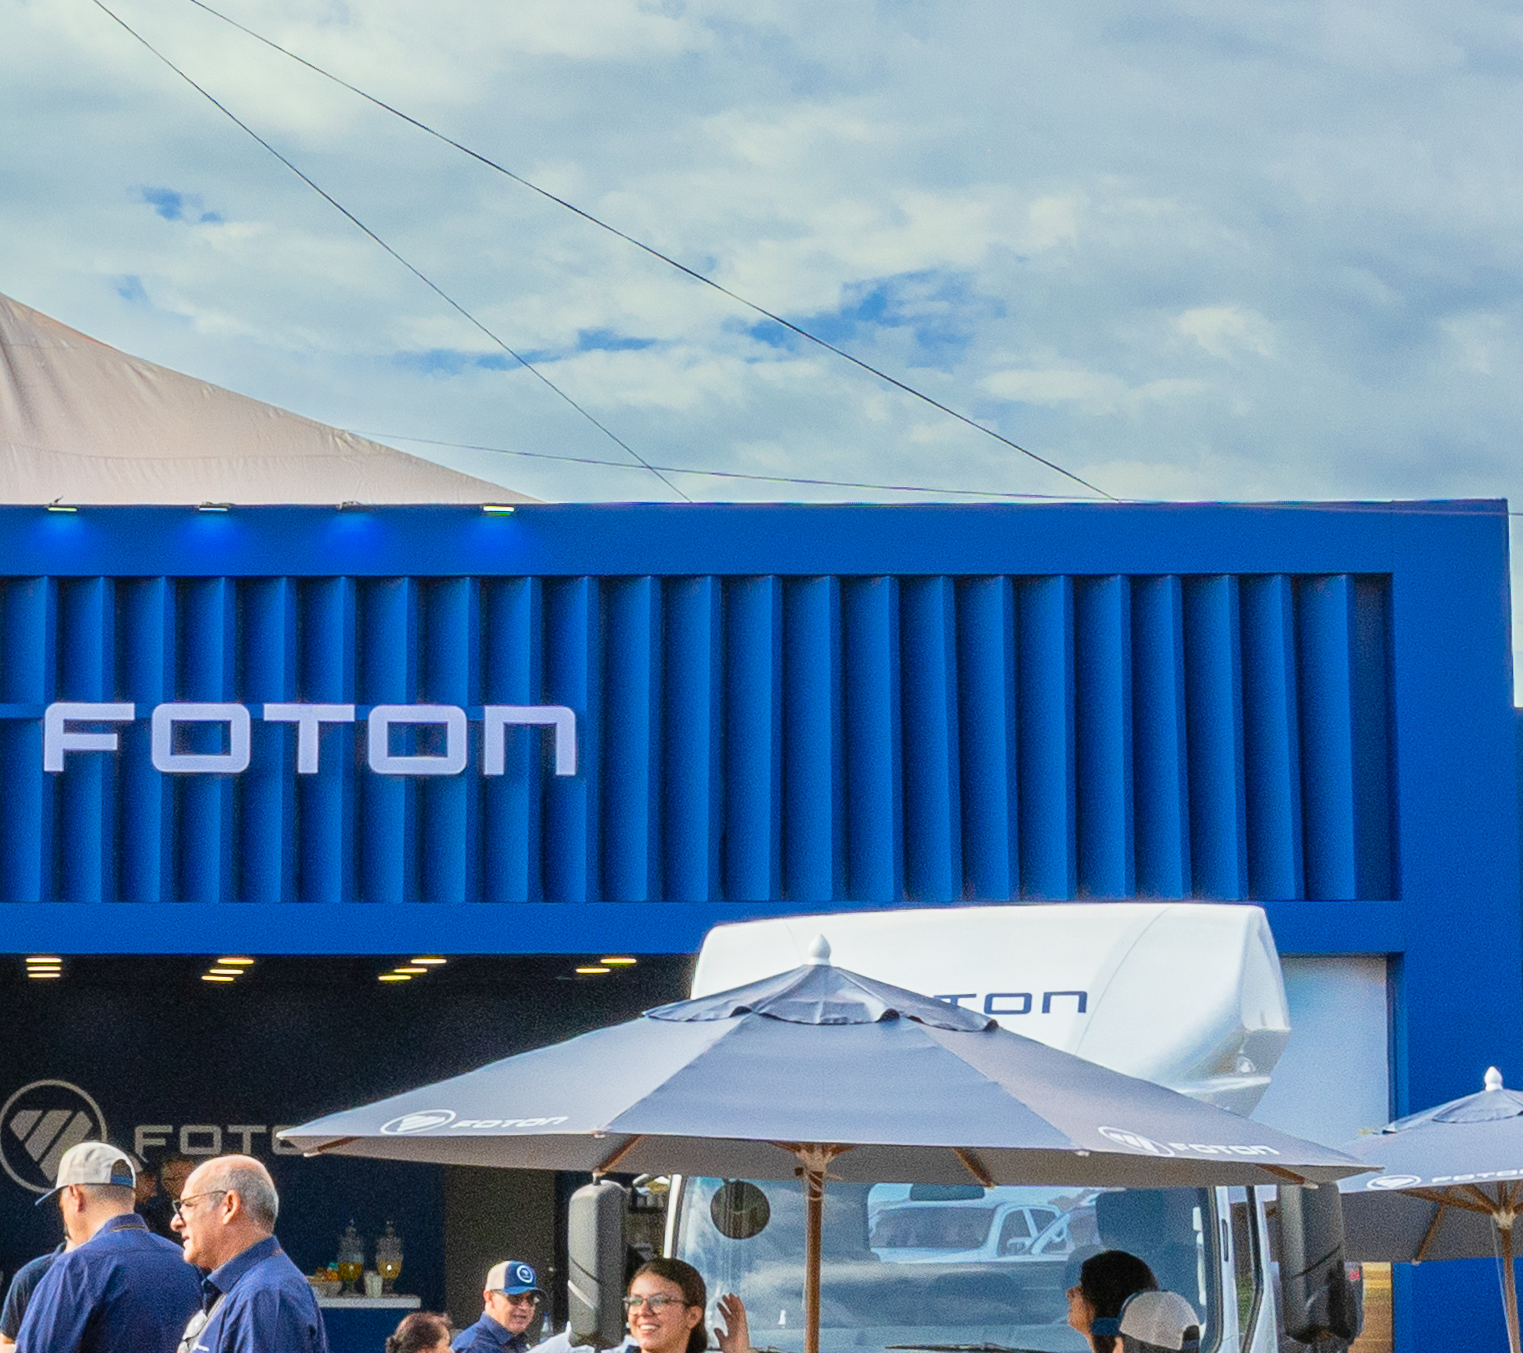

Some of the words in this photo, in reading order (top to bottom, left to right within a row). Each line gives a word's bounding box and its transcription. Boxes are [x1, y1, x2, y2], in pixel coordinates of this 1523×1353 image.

[43, 702, 577, 776] FOTON
[933, 990, 1088, 1015] TON
[450, 1116, 569, 1129] FOTON
[134, 1124, 306, 1155] FOTO
[1168, 1142, 1280, 1156] FOTON
